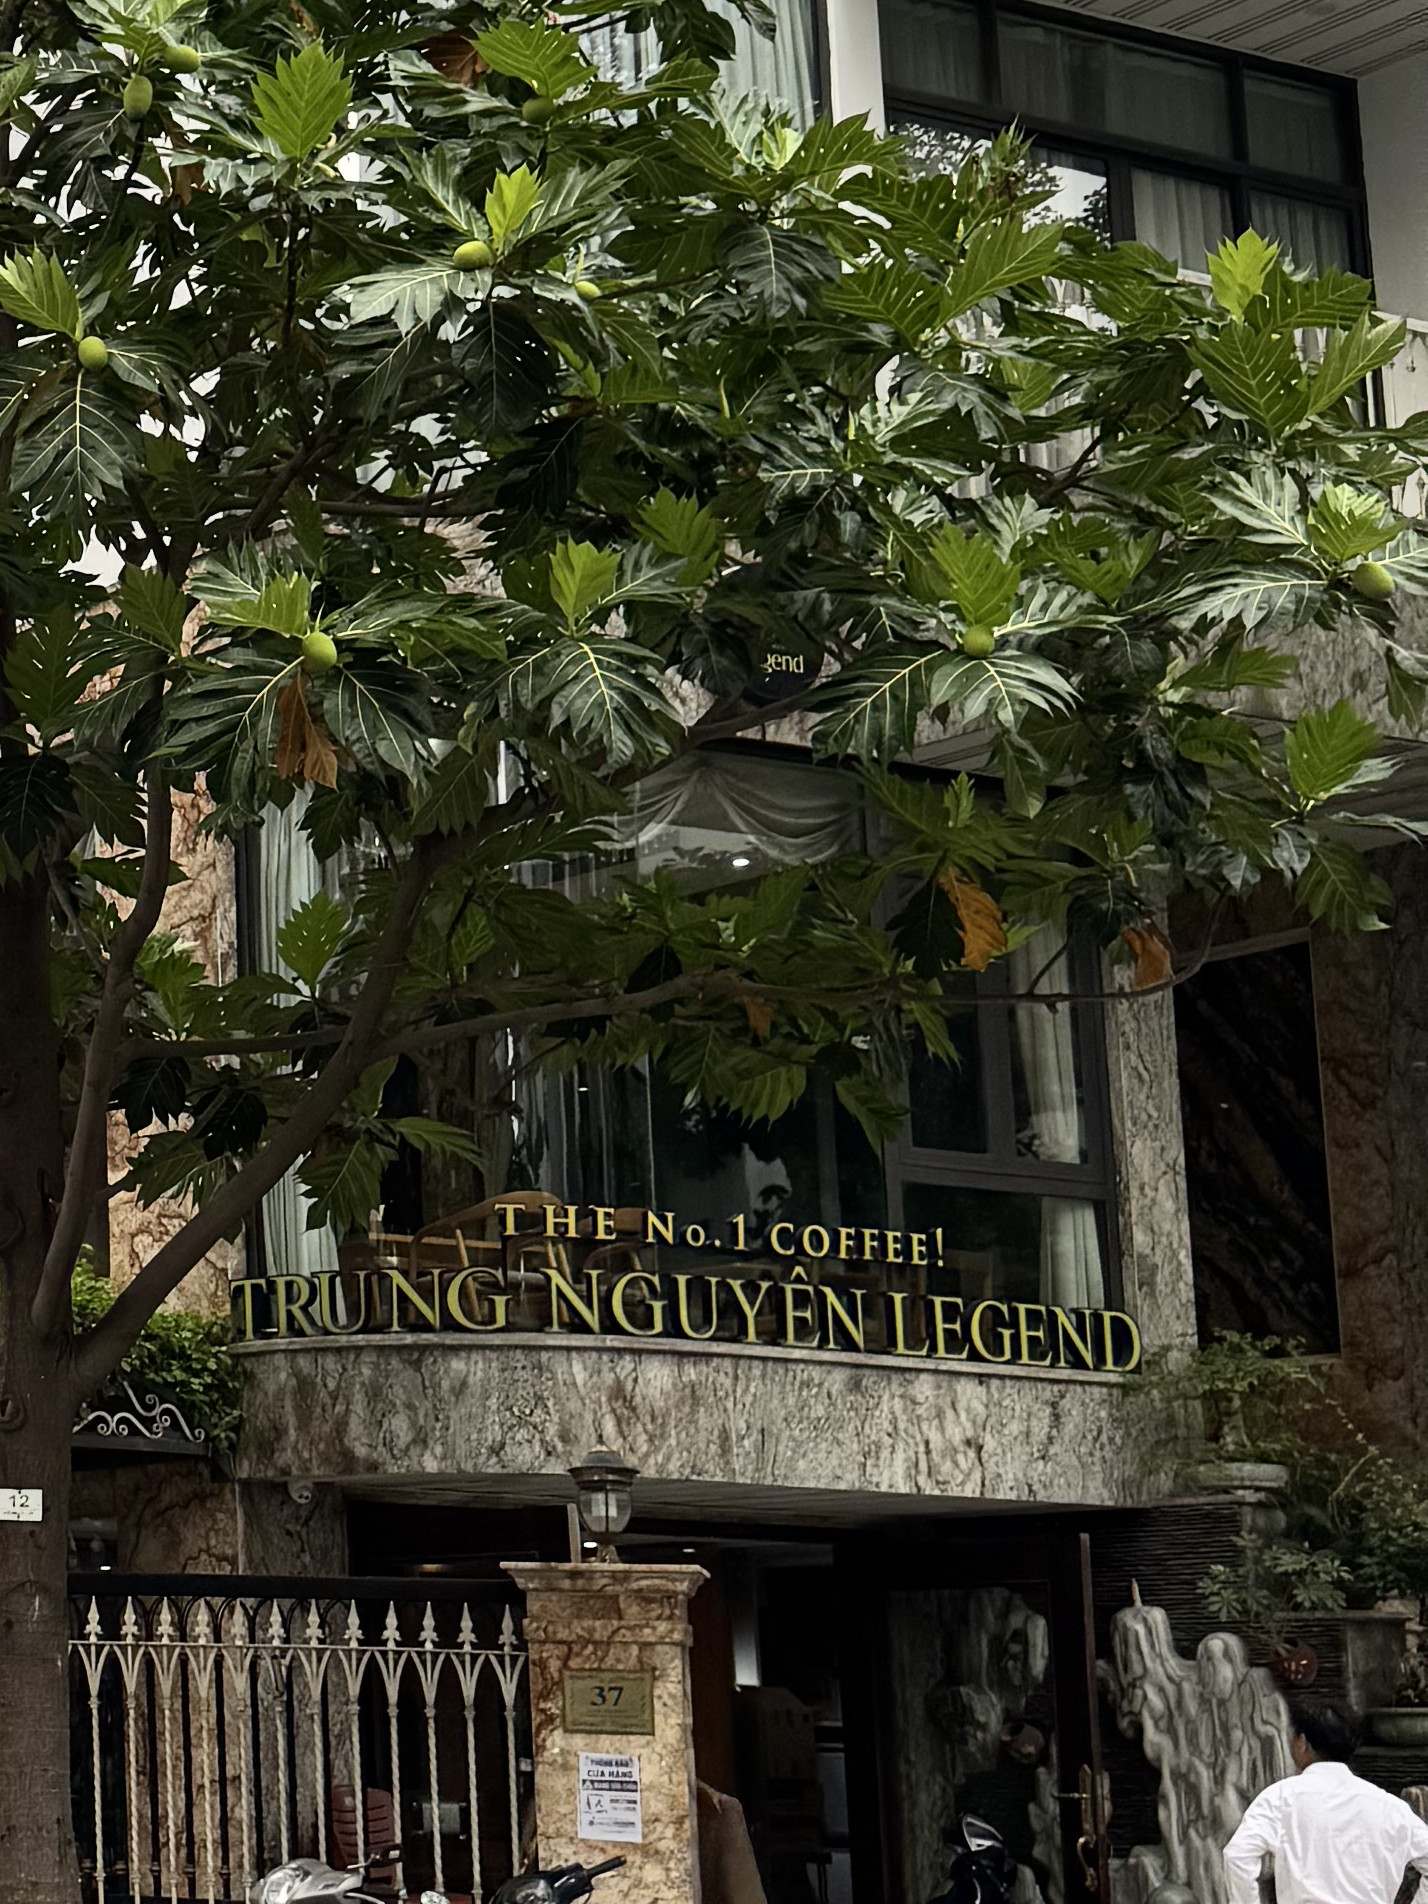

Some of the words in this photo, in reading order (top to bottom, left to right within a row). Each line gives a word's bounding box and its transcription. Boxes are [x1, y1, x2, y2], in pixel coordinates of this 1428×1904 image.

[494, 1202, 617, 1241] THE
[770, 1221, 945, 1268] COFFEE!
[230, 1266, 513, 1341] TRUNG
[540, 1265, 868, 1353] NGUYÊN
[887, 1291, 1143, 1373] LEGEND
[8, 1494, 30, 1508] 12
[590, 1685, 624, 1707] 37
